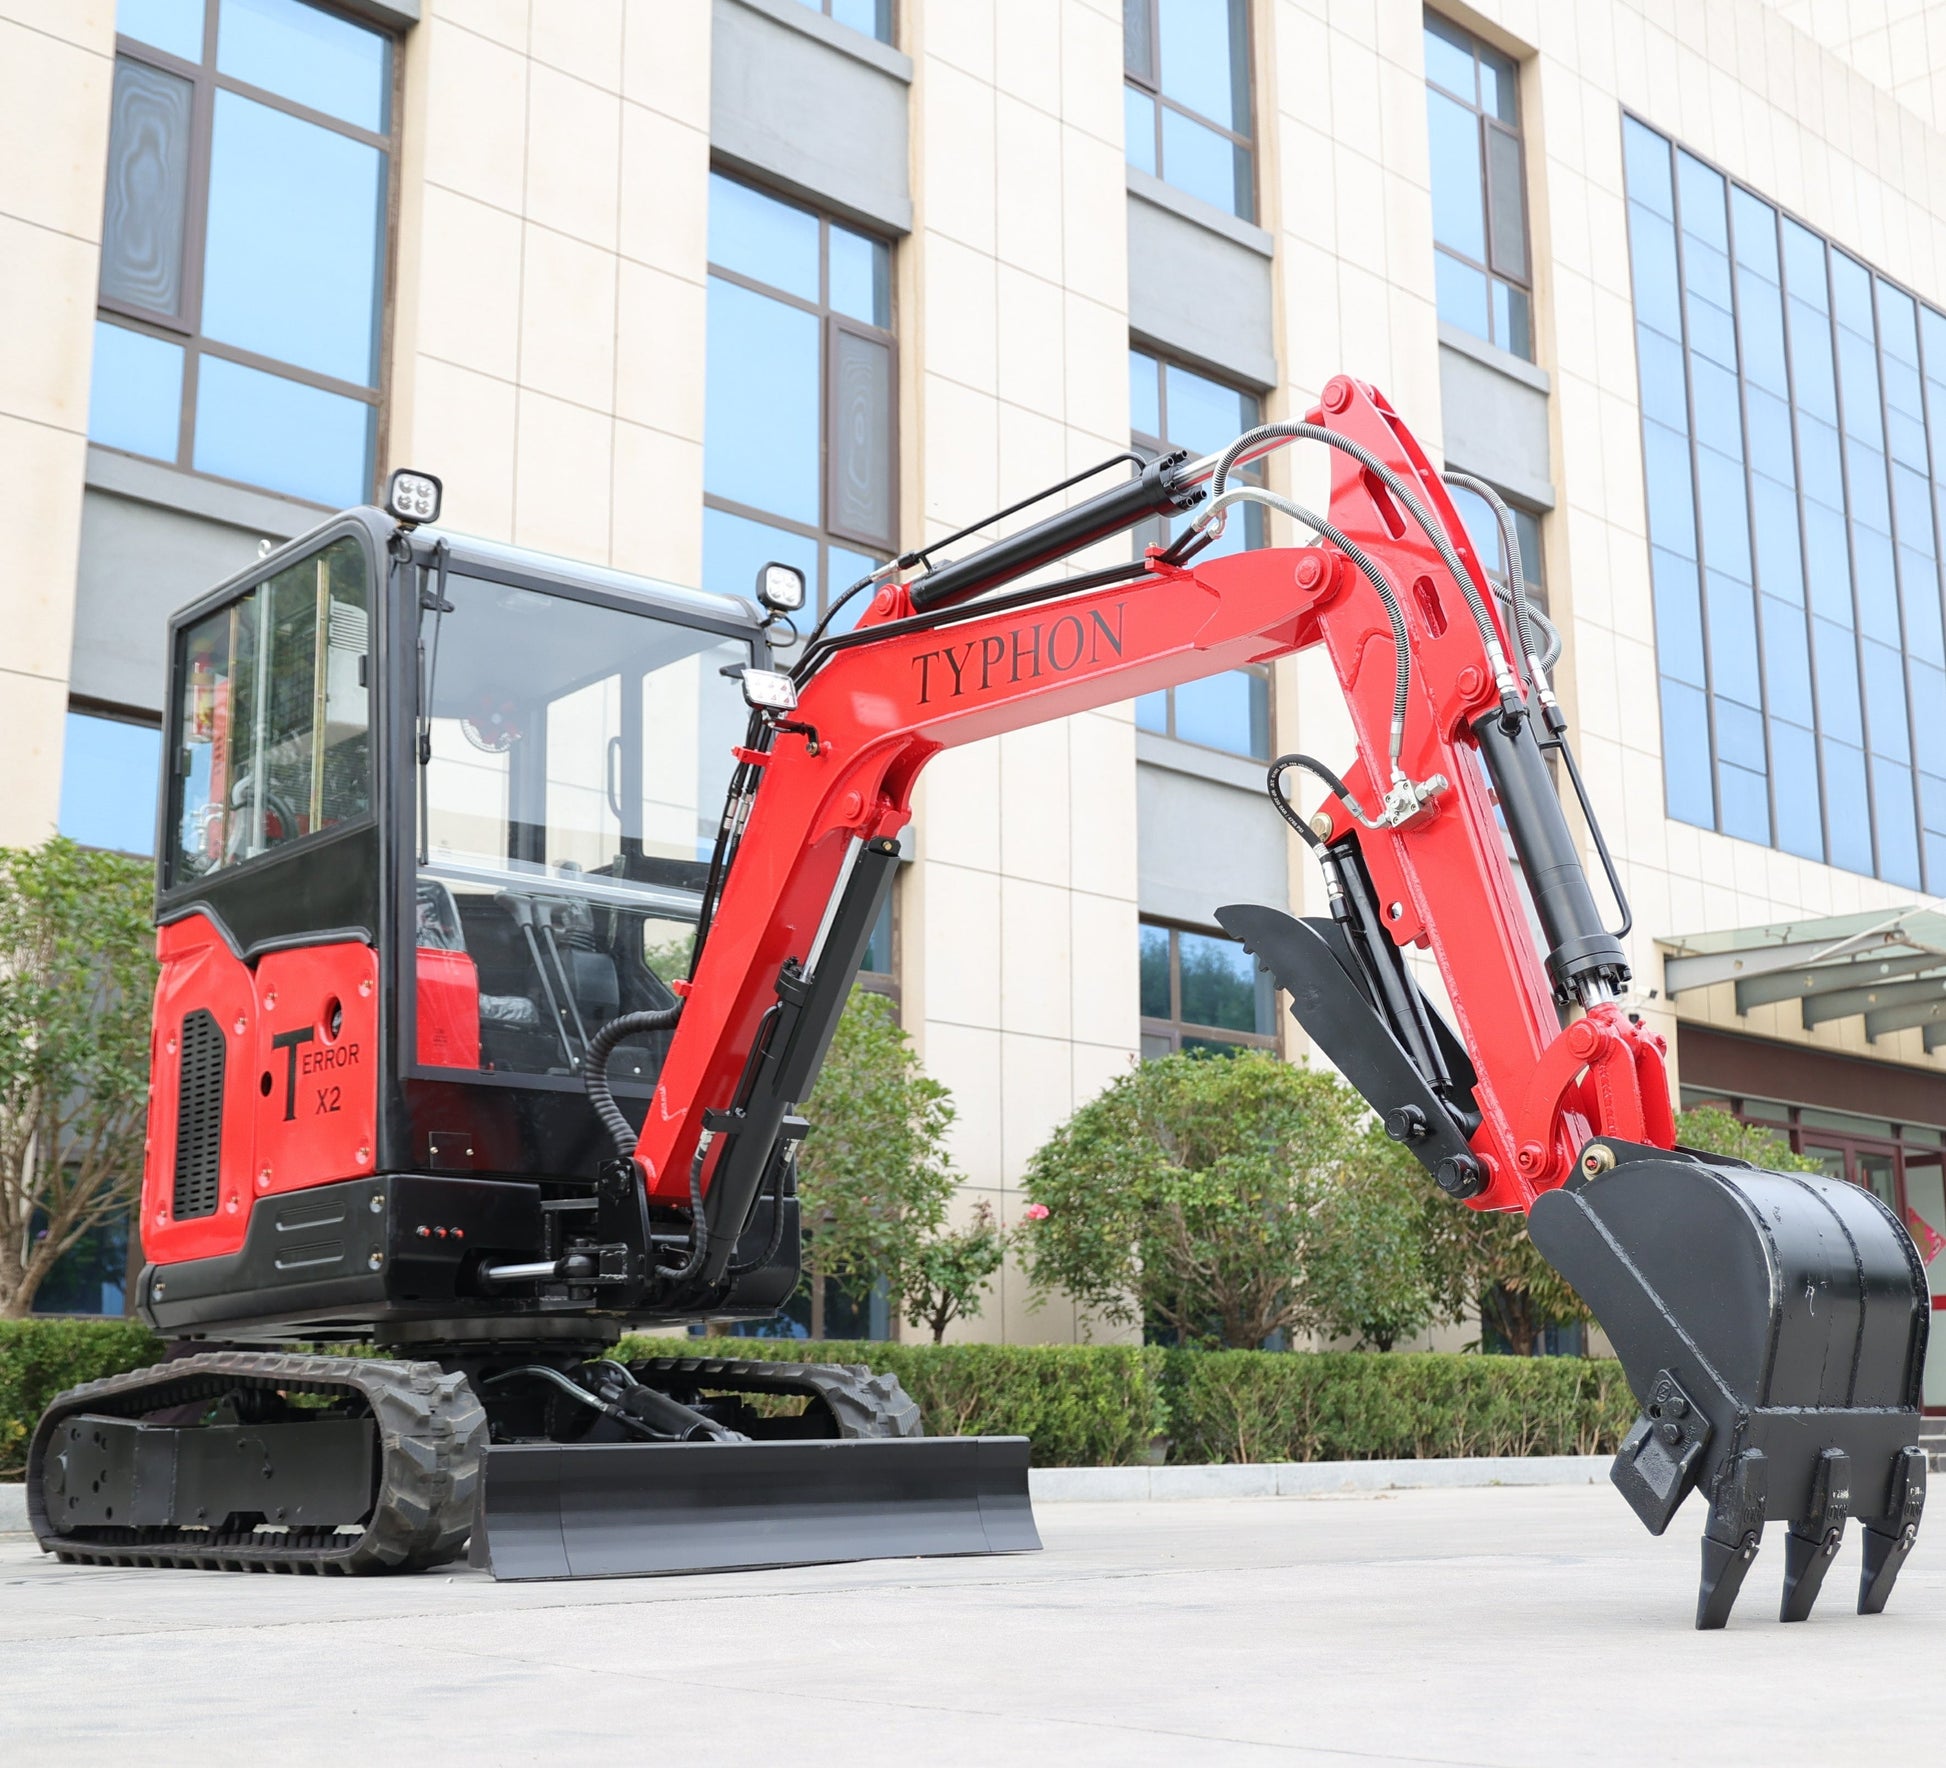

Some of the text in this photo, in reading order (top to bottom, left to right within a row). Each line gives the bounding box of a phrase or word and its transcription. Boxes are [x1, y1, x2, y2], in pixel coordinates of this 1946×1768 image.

[912, 602, 1127, 705] TYPHON
[1279, 806, 1288, 815] BAR
[1296, 825, 1304, 833] PSI
[272, 1025, 360, 1122] TERROR
[315, 1086, 342, 1115] X2
